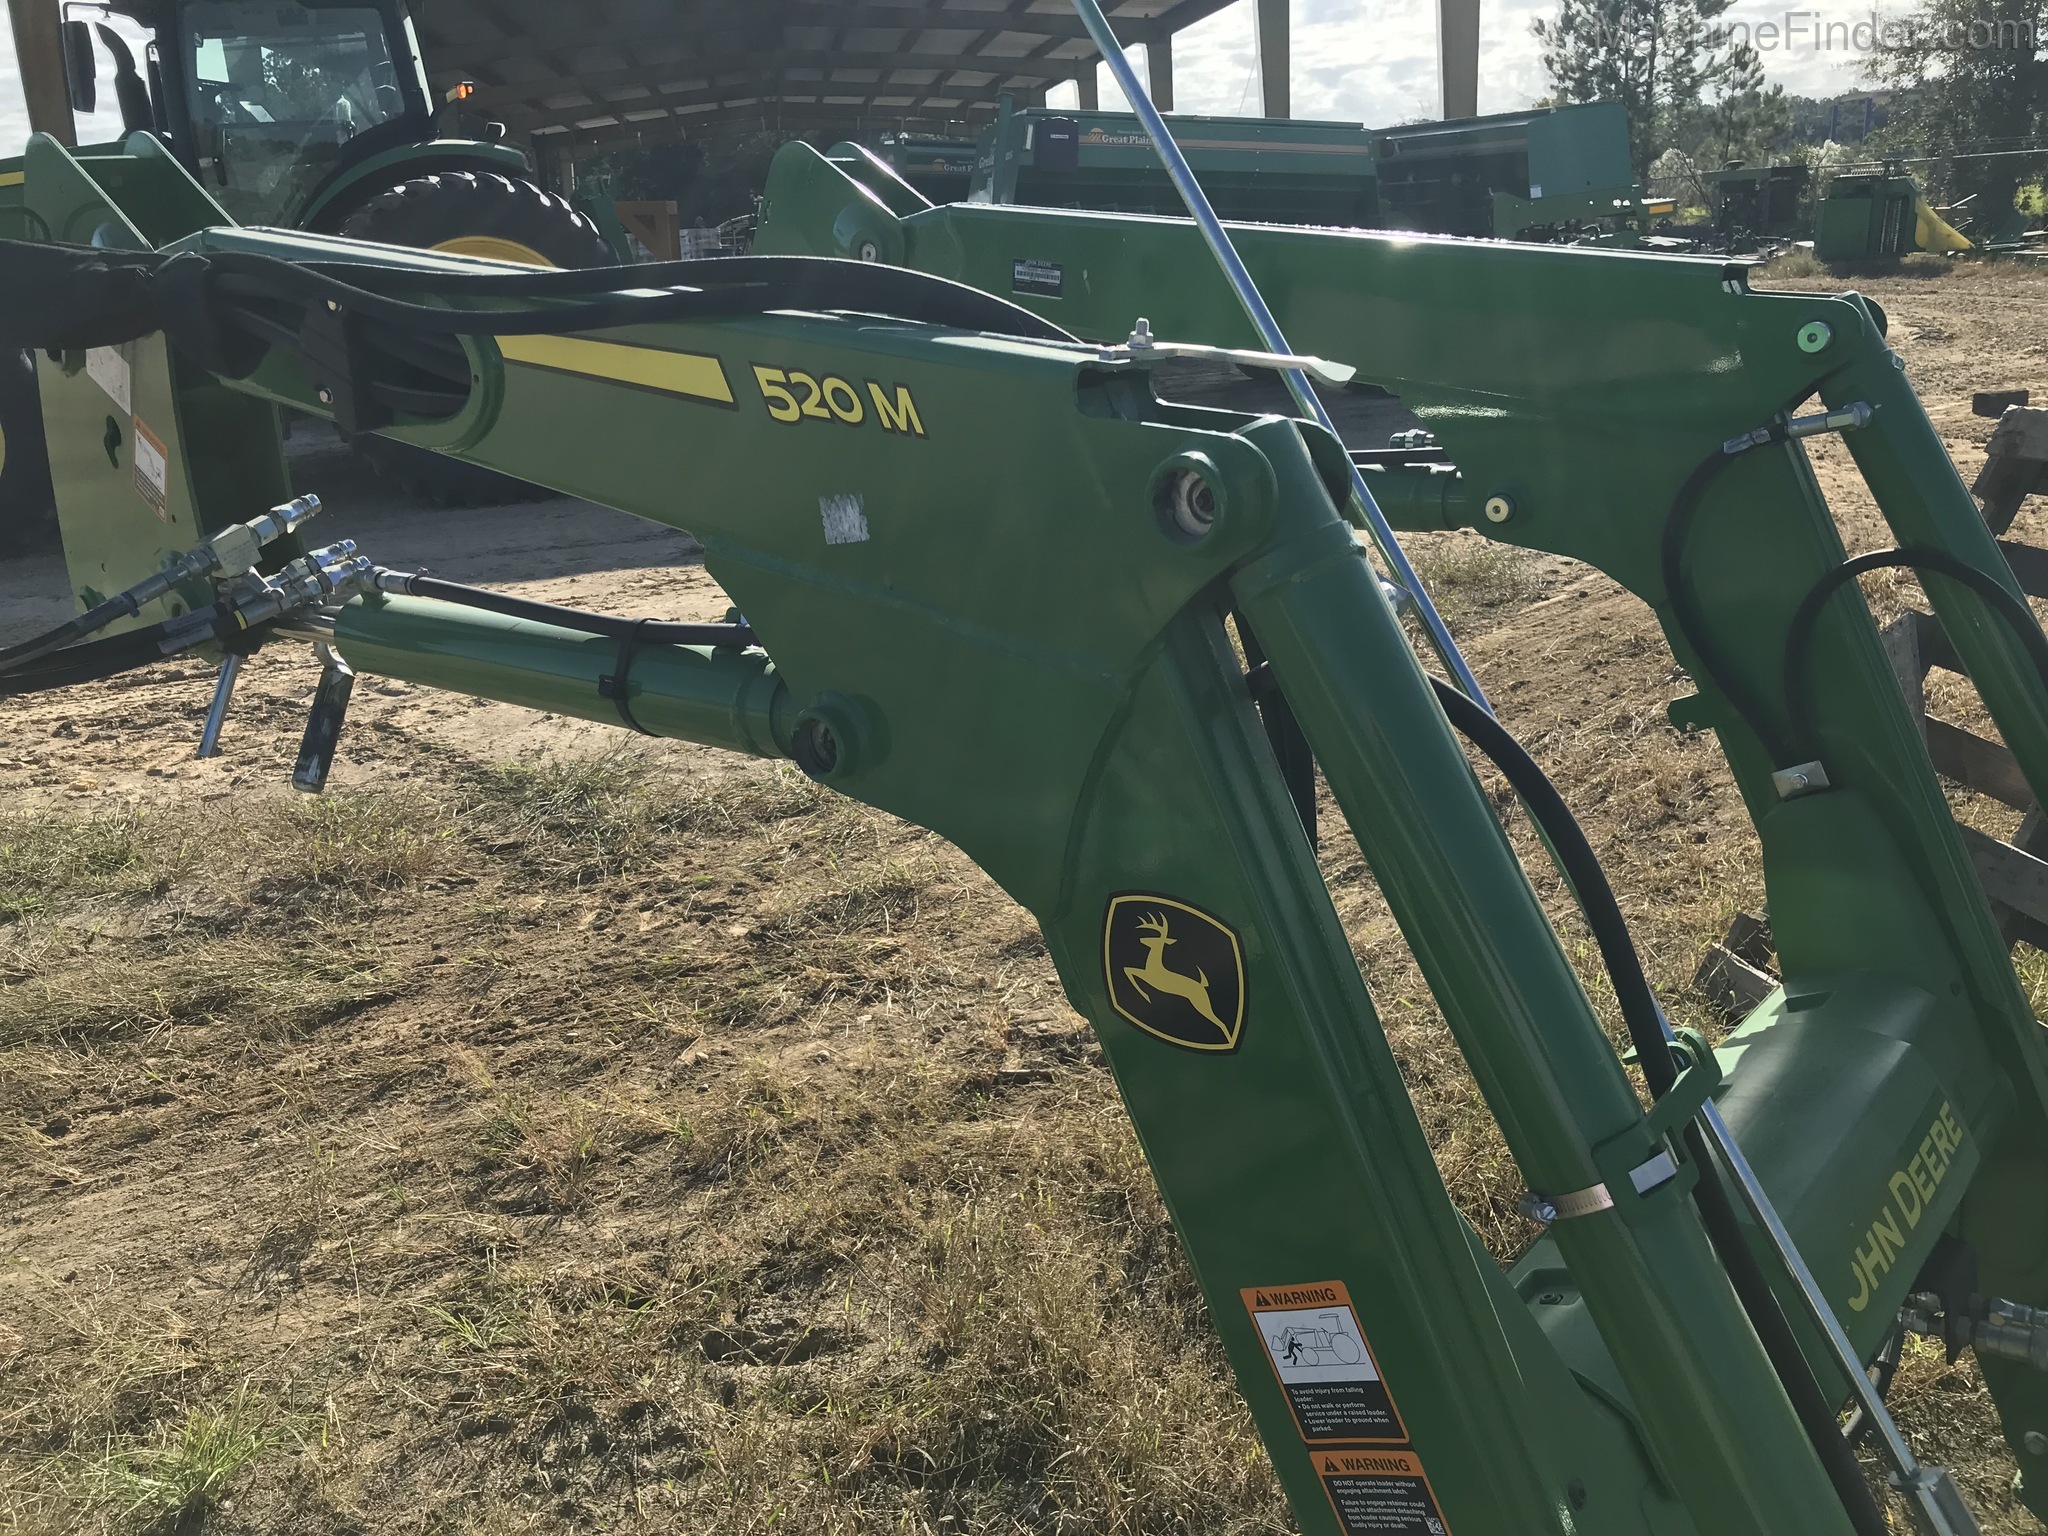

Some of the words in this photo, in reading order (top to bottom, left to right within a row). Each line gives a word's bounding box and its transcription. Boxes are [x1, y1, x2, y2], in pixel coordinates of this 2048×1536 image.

[1101, 134, 1128, 144] Great
[751, 364, 866, 425] 520
[866, 381, 926, 436] M
[1888, 1101, 1963, 1230] DEERE
[1269, 1288, 1336, 1305] WARNING
[1340, 1458, 1411, 1472] WARNING
